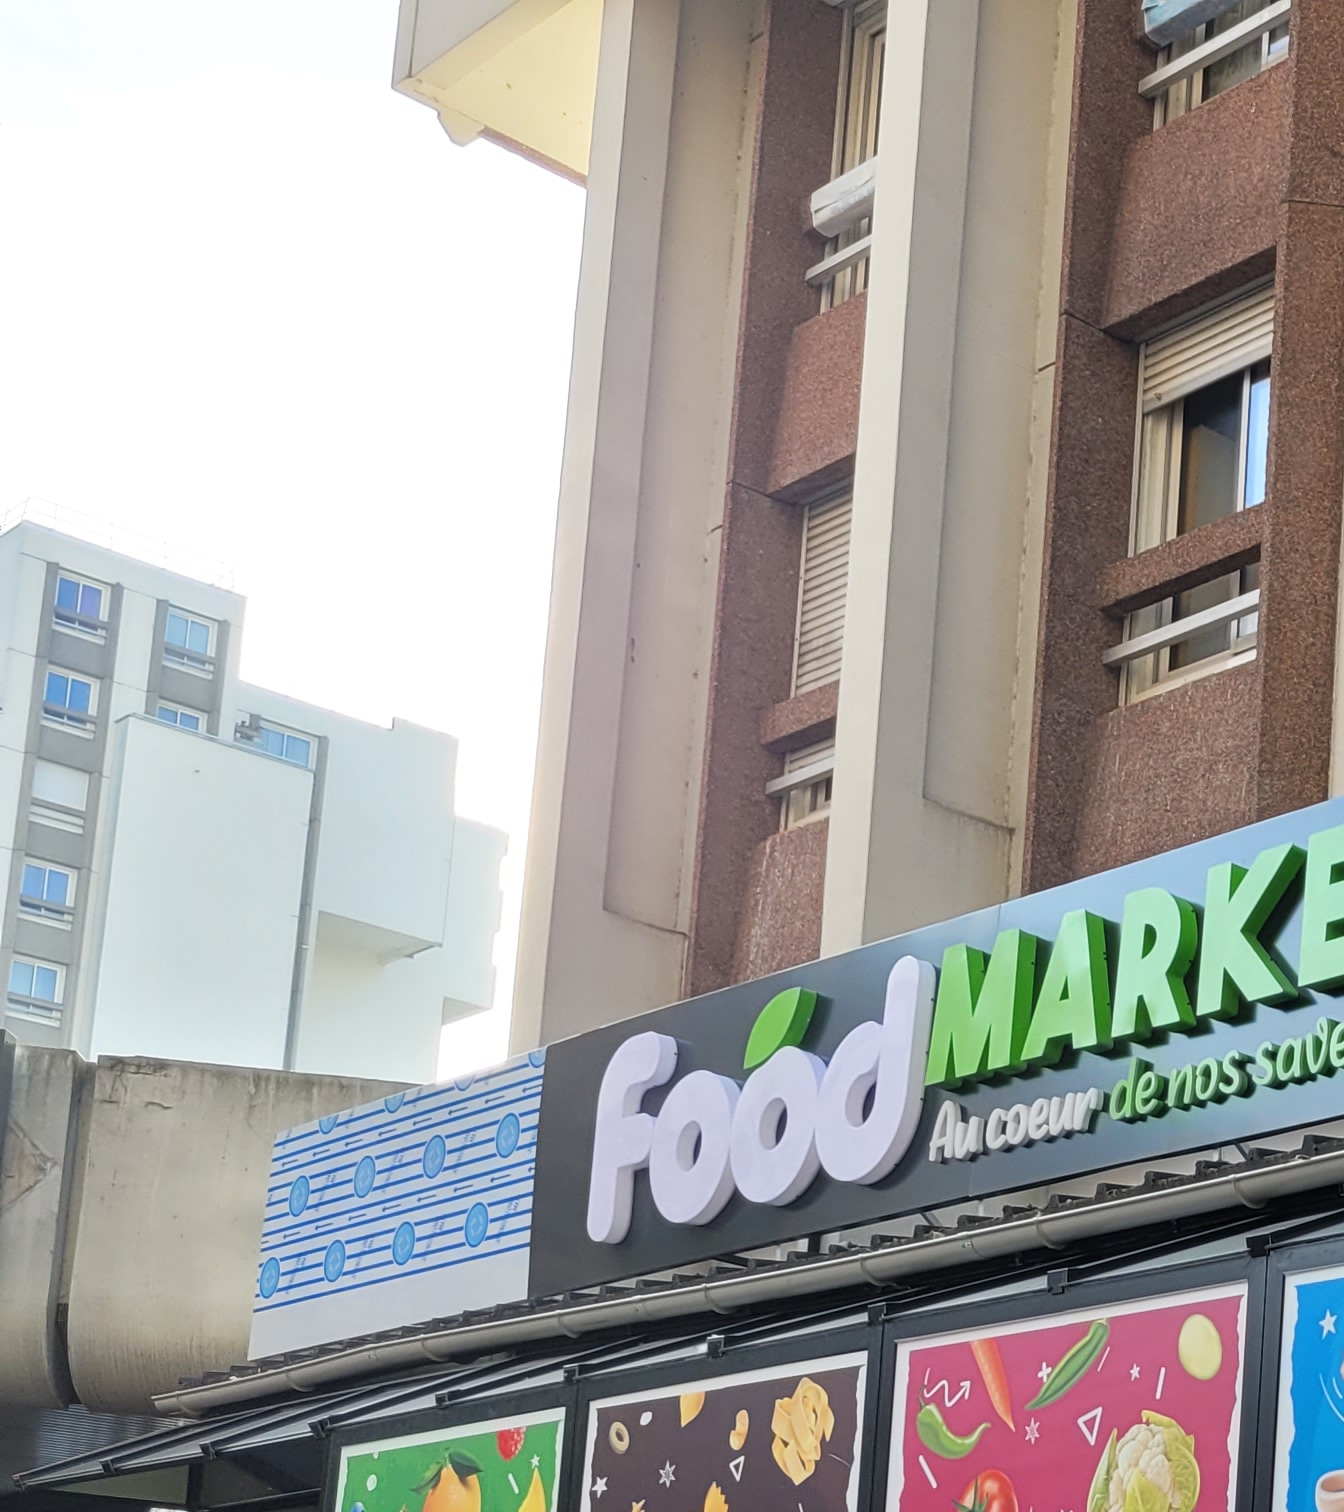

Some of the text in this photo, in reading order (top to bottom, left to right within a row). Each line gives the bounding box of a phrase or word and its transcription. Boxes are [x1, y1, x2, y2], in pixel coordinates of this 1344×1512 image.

[928, 1100, 984, 1164] Au
[984, 1086, 1102, 1153] coeur
[1109, 1057, 1165, 1123] de
[1166, 1047, 1248, 1110] nos
